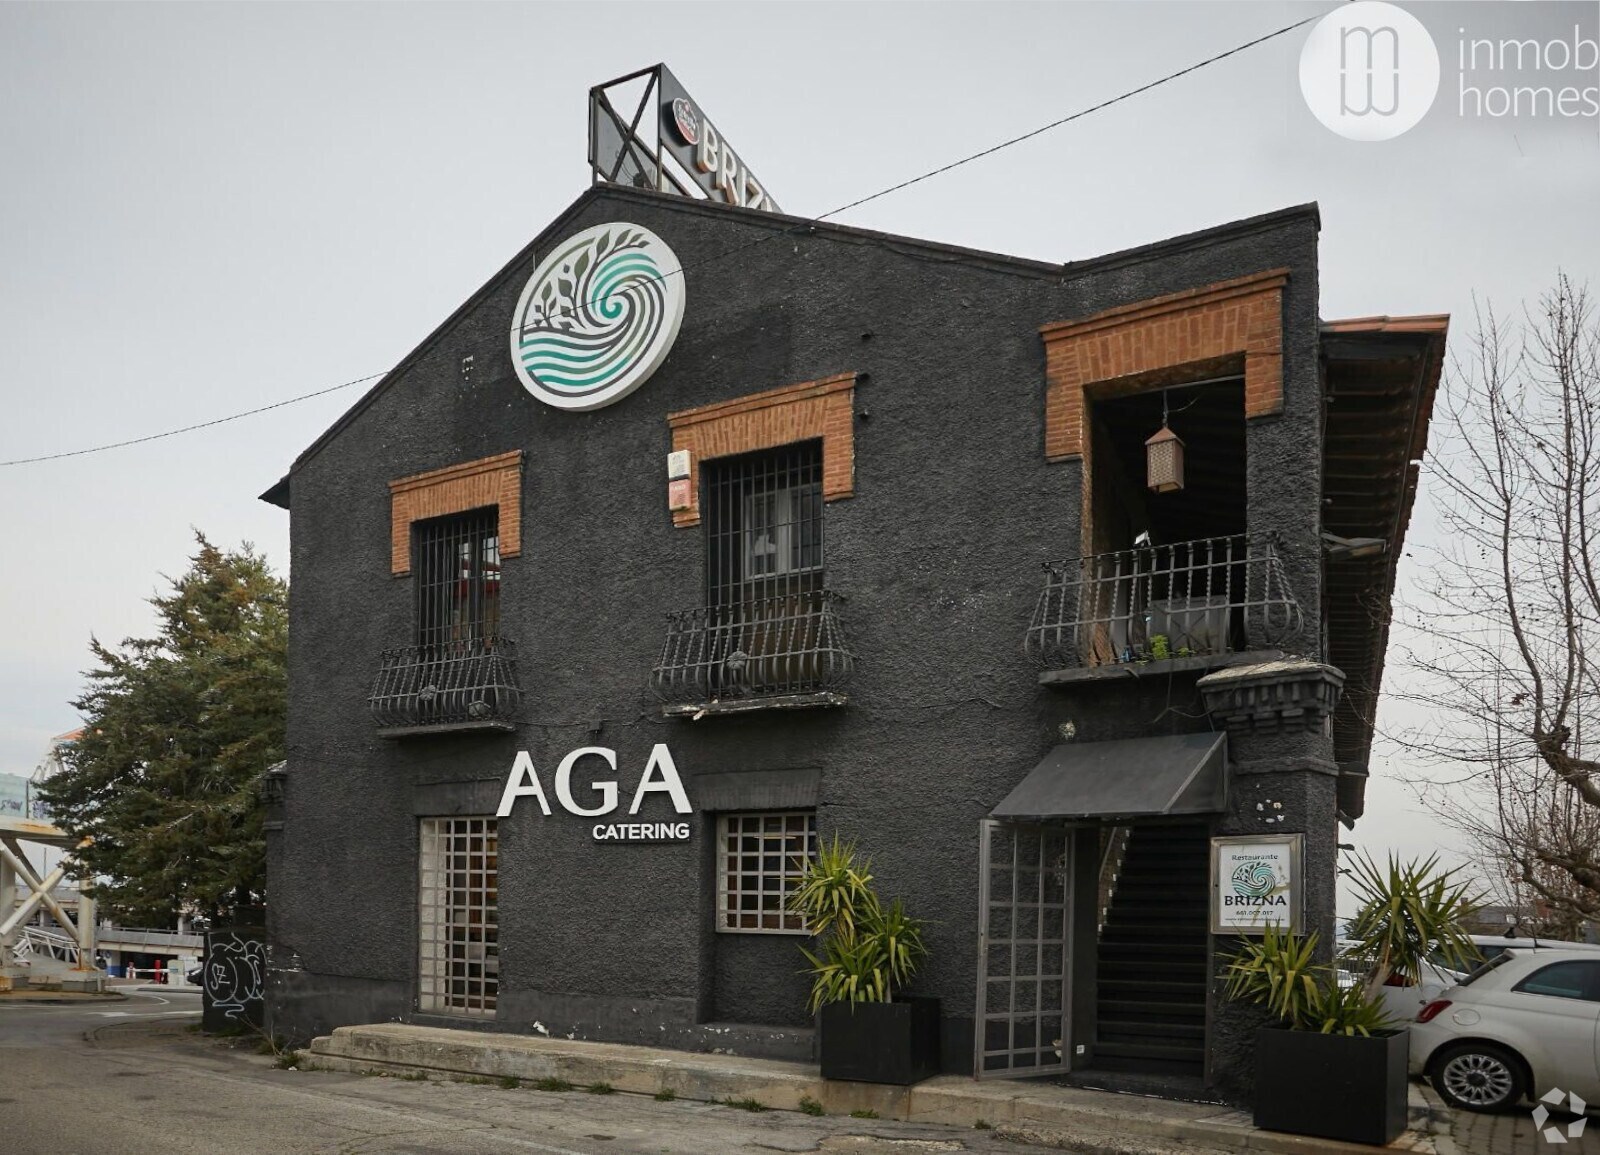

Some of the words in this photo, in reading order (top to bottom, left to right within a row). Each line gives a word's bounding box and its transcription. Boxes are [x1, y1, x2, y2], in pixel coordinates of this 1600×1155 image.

[697, 117, 772, 212] BRIZ
[496, 743, 693, 817] AGA
[592, 823, 690, 840] CATERING
[1224, 895, 1287, 906] BRIZNA
